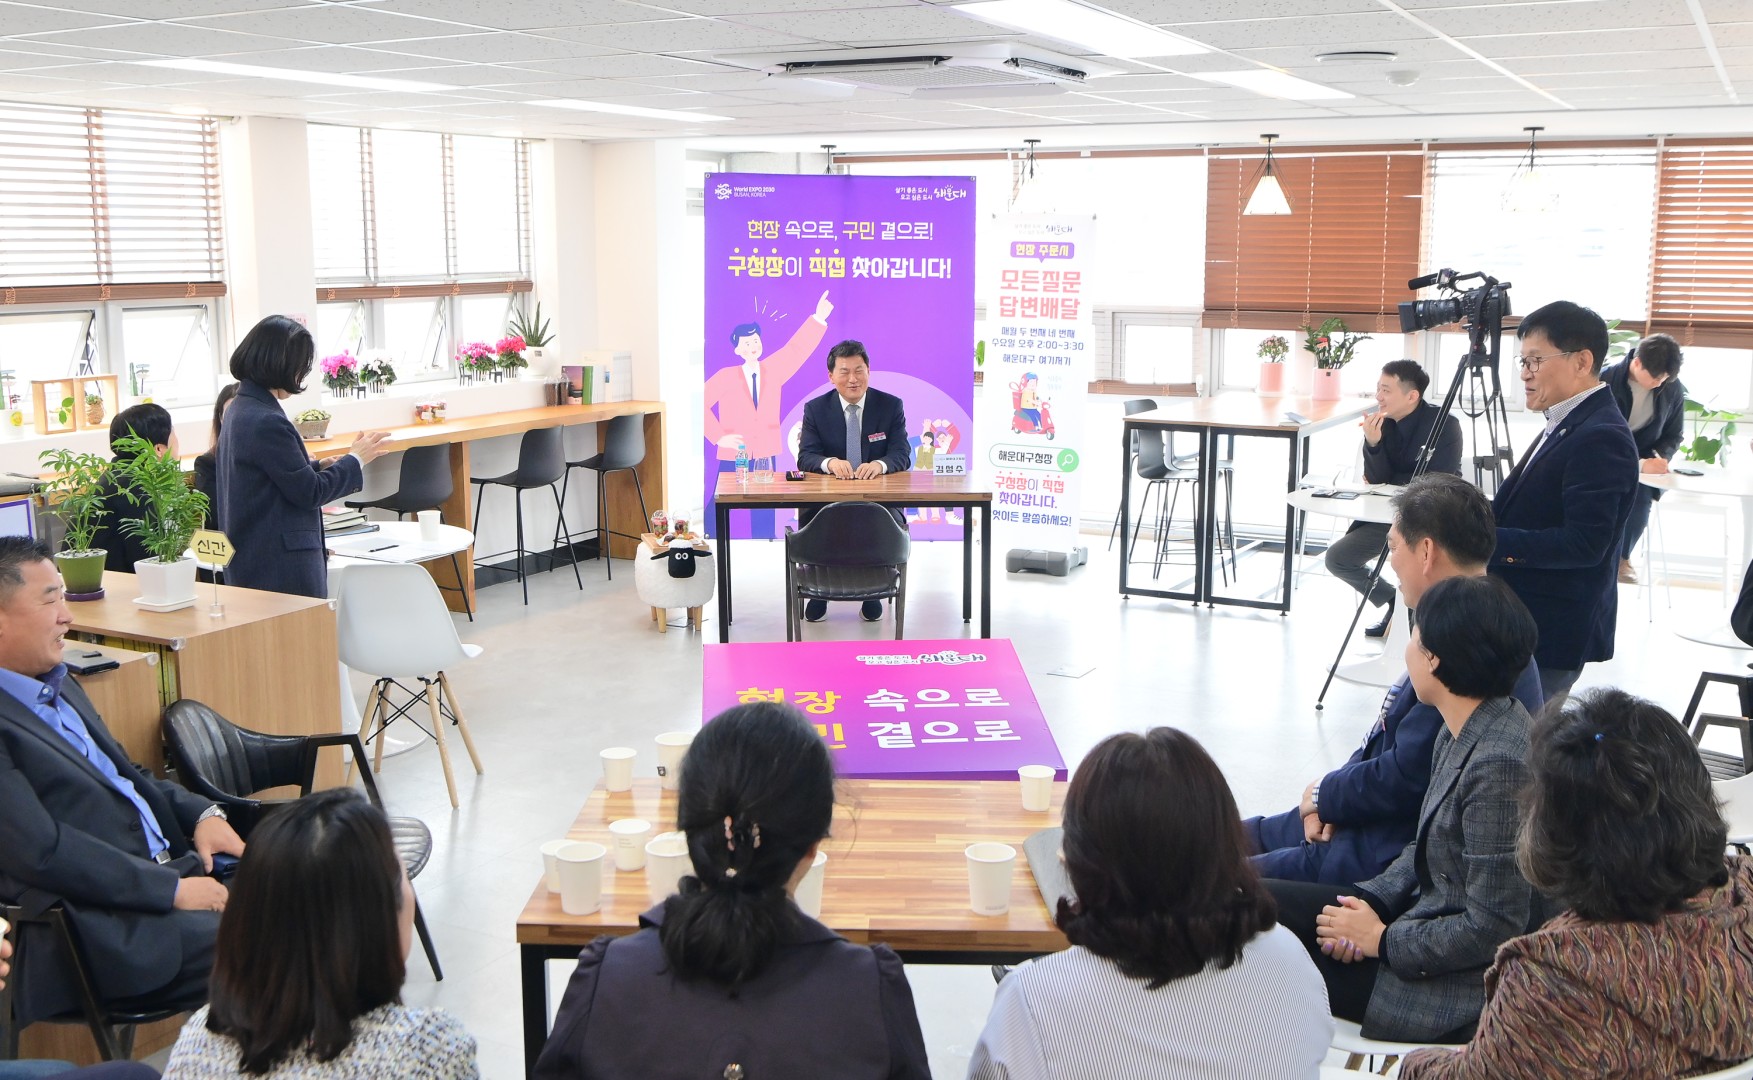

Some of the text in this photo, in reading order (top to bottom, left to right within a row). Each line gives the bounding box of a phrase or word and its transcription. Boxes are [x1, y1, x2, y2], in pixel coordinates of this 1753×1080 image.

[934, 184, 967, 201] 해운대
[748, 219, 933, 242] 현장 속으로, 구민 곁으로!
[1039, 244, 1069, 257] 주문서
[728, 256, 951, 279] 구청장이 직접 찾아갑니다!
[1001, 269, 1081, 294] 모든질문
[1000, 295, 1080, 320] 답변배달
[1001, 326, 1017, 336] 매월
[992, 338, 1016, 348] 수요일
[1018, 339, 1035, 349] 오후
[1002, 353, 1036, 364] 해운대구
[998, 450, 1053, 465] 해운대구청장
[994, 475, 1065, 494] 구청장이 직접
[999, 491, 1058, 509] 찾아갑니다.
[992, 509, 1072, 527] 엇이든 말씀하세요!
[197, 539, 226, 557] 신간
[863, 688, 1011, 713] 속으로
[813, 720, 1022, 749] 민 곁으로
